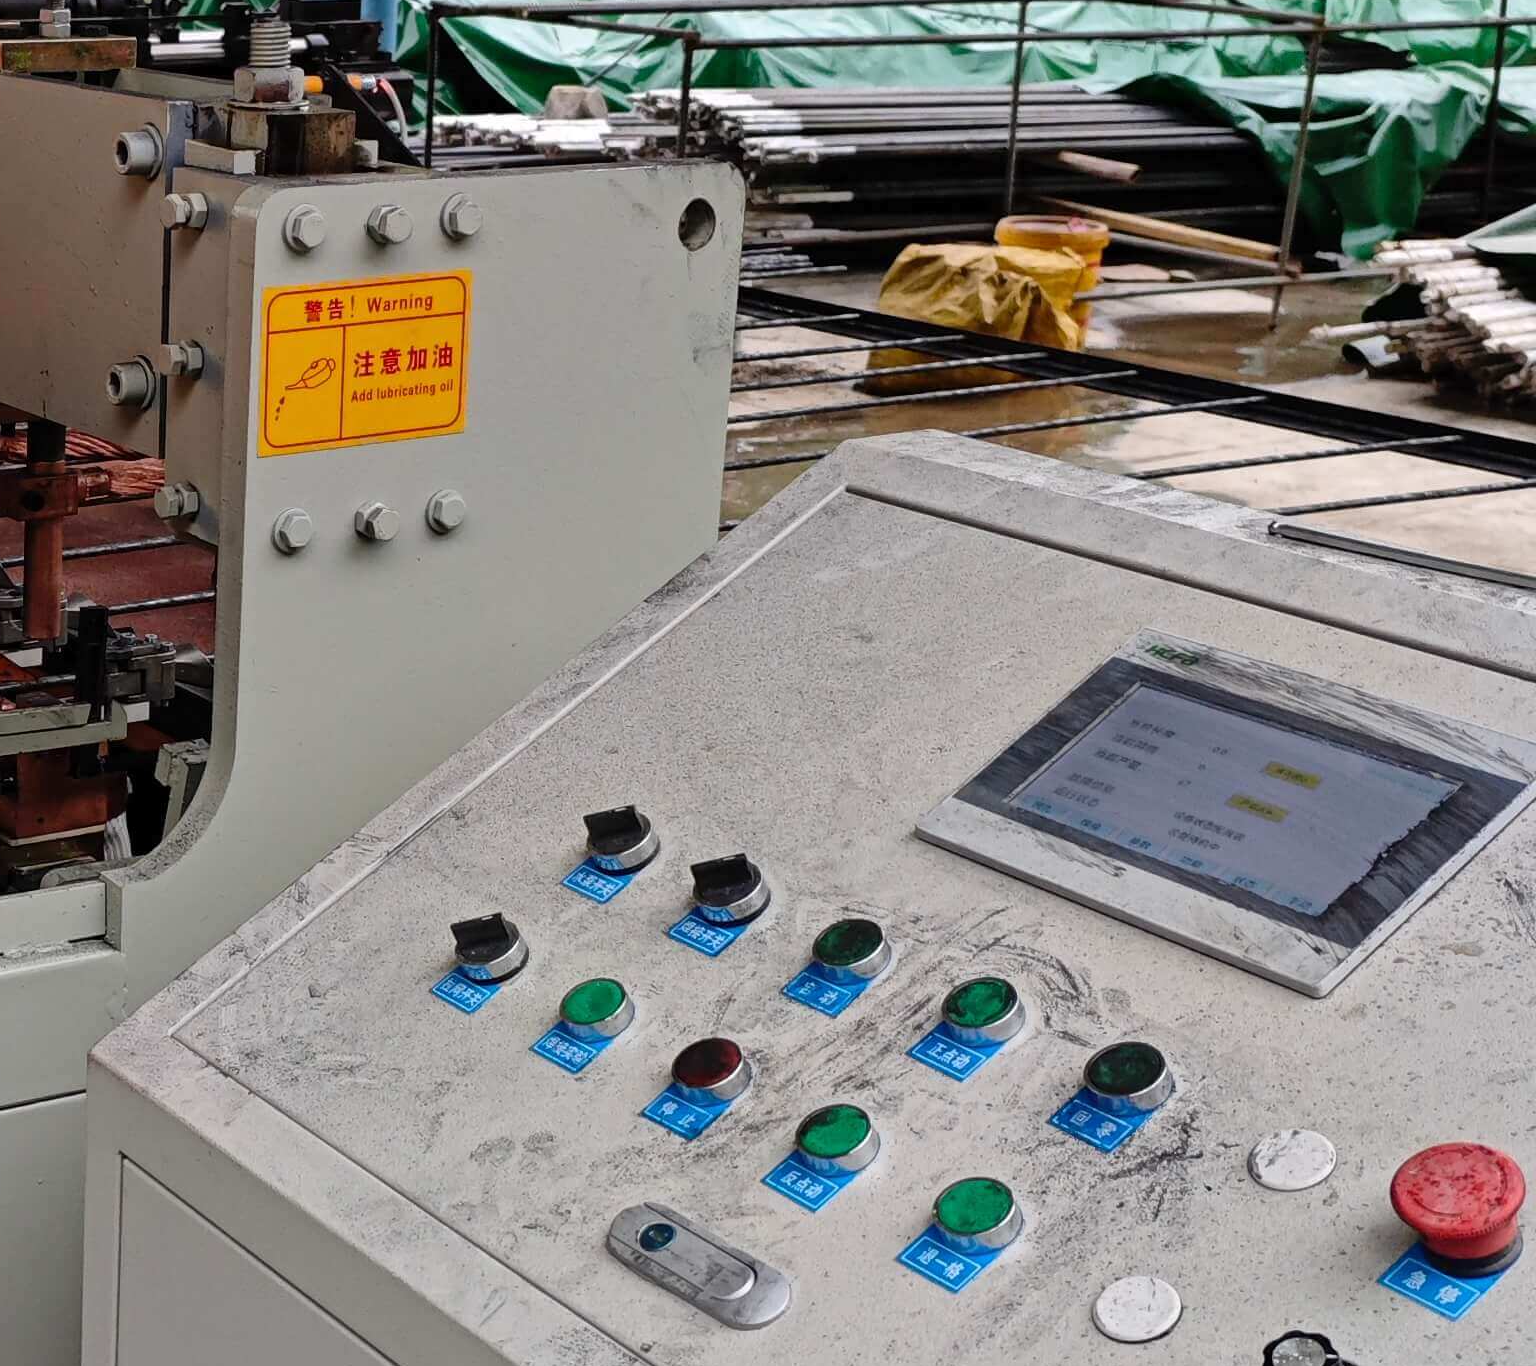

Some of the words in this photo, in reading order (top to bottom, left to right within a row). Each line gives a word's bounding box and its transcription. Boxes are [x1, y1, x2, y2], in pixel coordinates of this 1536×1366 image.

[367, 295, 433, 313] Warning
[353, 341, 454, 378] 注意加油
[351, 390, 373, 403] Add
[377, 383, 436, 400] lubricating
[440, 379, 454, 392] oil
[931, 1042, 972, 1069] 正点动
[661, 1102, 697, 1128] 停止
[781, 1171, 823, 1198] 反点动
[1402, 1270, 1463, 1304] 急停
